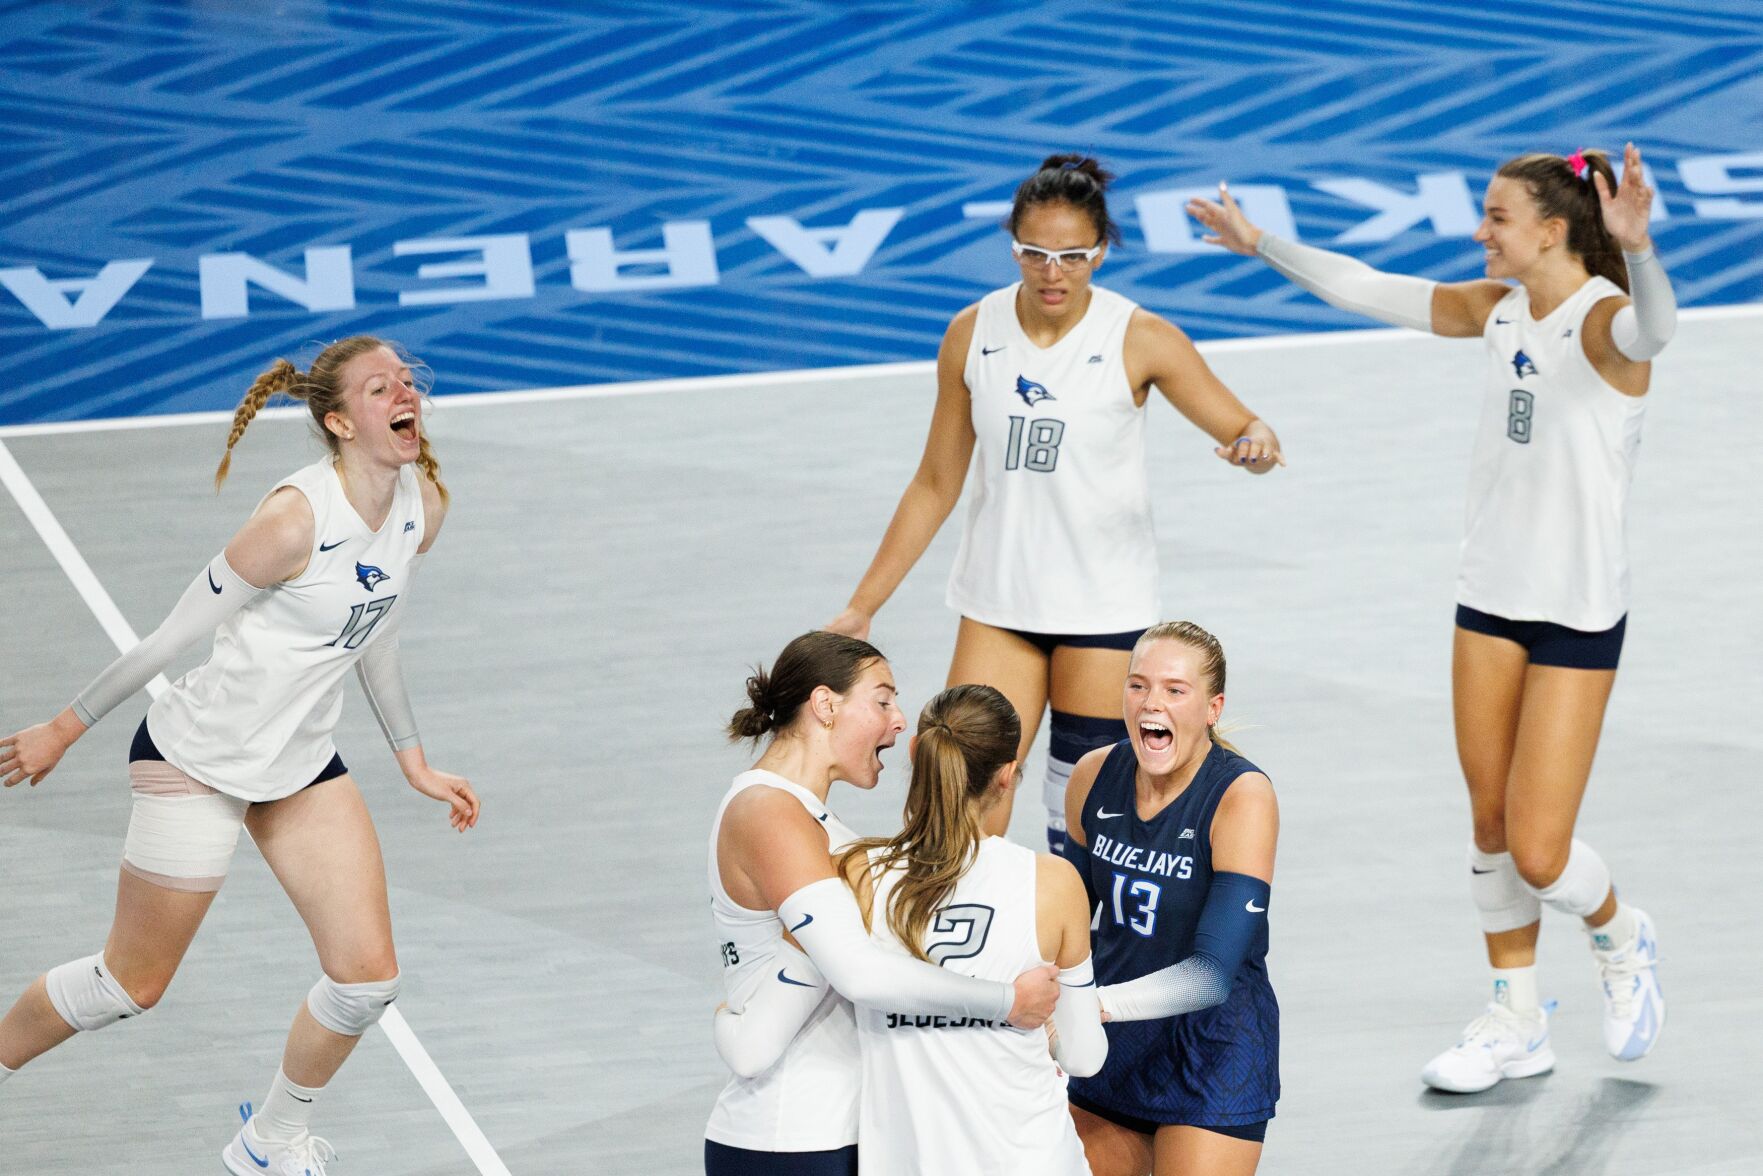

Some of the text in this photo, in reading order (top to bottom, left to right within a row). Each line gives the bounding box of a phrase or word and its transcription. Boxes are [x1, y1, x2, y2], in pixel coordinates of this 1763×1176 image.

[0, 208, 904, 330] ARENA
[1005, 415, 1066, 473] 18
[1507, 389, 1534, 444] 8
[322, 594, 398, 649] 17
[1092, 833, 1194, 880] BLUEJAYS
[1111, 870, 1163, 938] 13
[926, 903, 996, 968] 2
